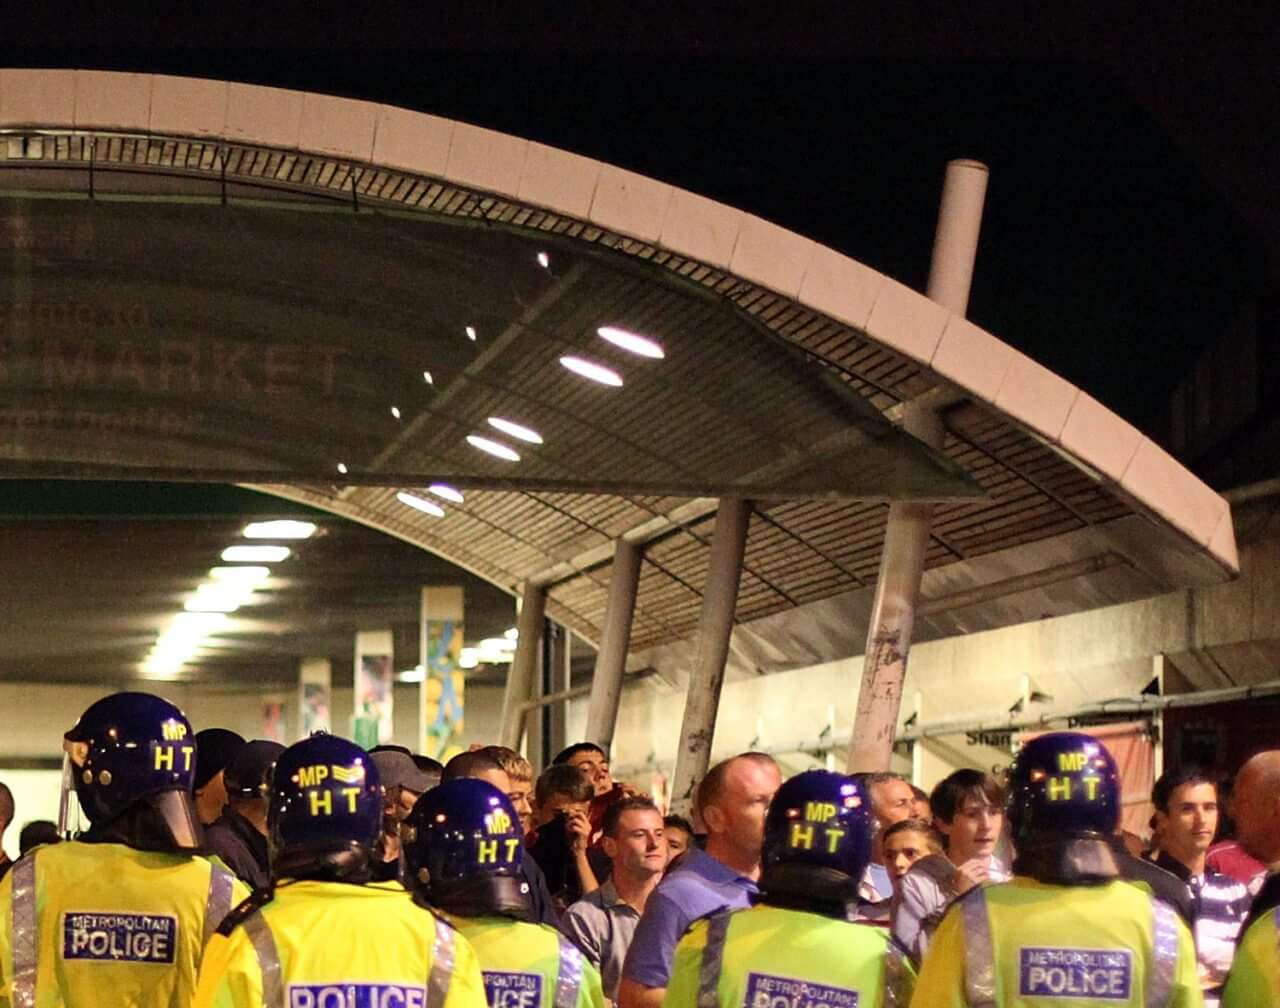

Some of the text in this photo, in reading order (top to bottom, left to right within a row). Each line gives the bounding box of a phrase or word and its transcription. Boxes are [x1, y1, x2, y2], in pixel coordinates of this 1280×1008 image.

[41, 336, 346, 395] MARKET
[162, 721, 187, 741] MP
[1059, 752, 1089, 771] MP
[299, 765, 329, 788] MP
[806, 801, 836, 823] MP
[485, 812, 511, 835] MP
[71, 915, 170, 932] METROPOLITAN
[71, 928, 169, 959] POLICE
[1028, 950, 1126, 967] METROPOLITAN
[484, 974, 537, 990] POLITAN
[755, 977, 853, 1003] METROPOLITAN
[1028, 966, 1125, 994] POLICE
